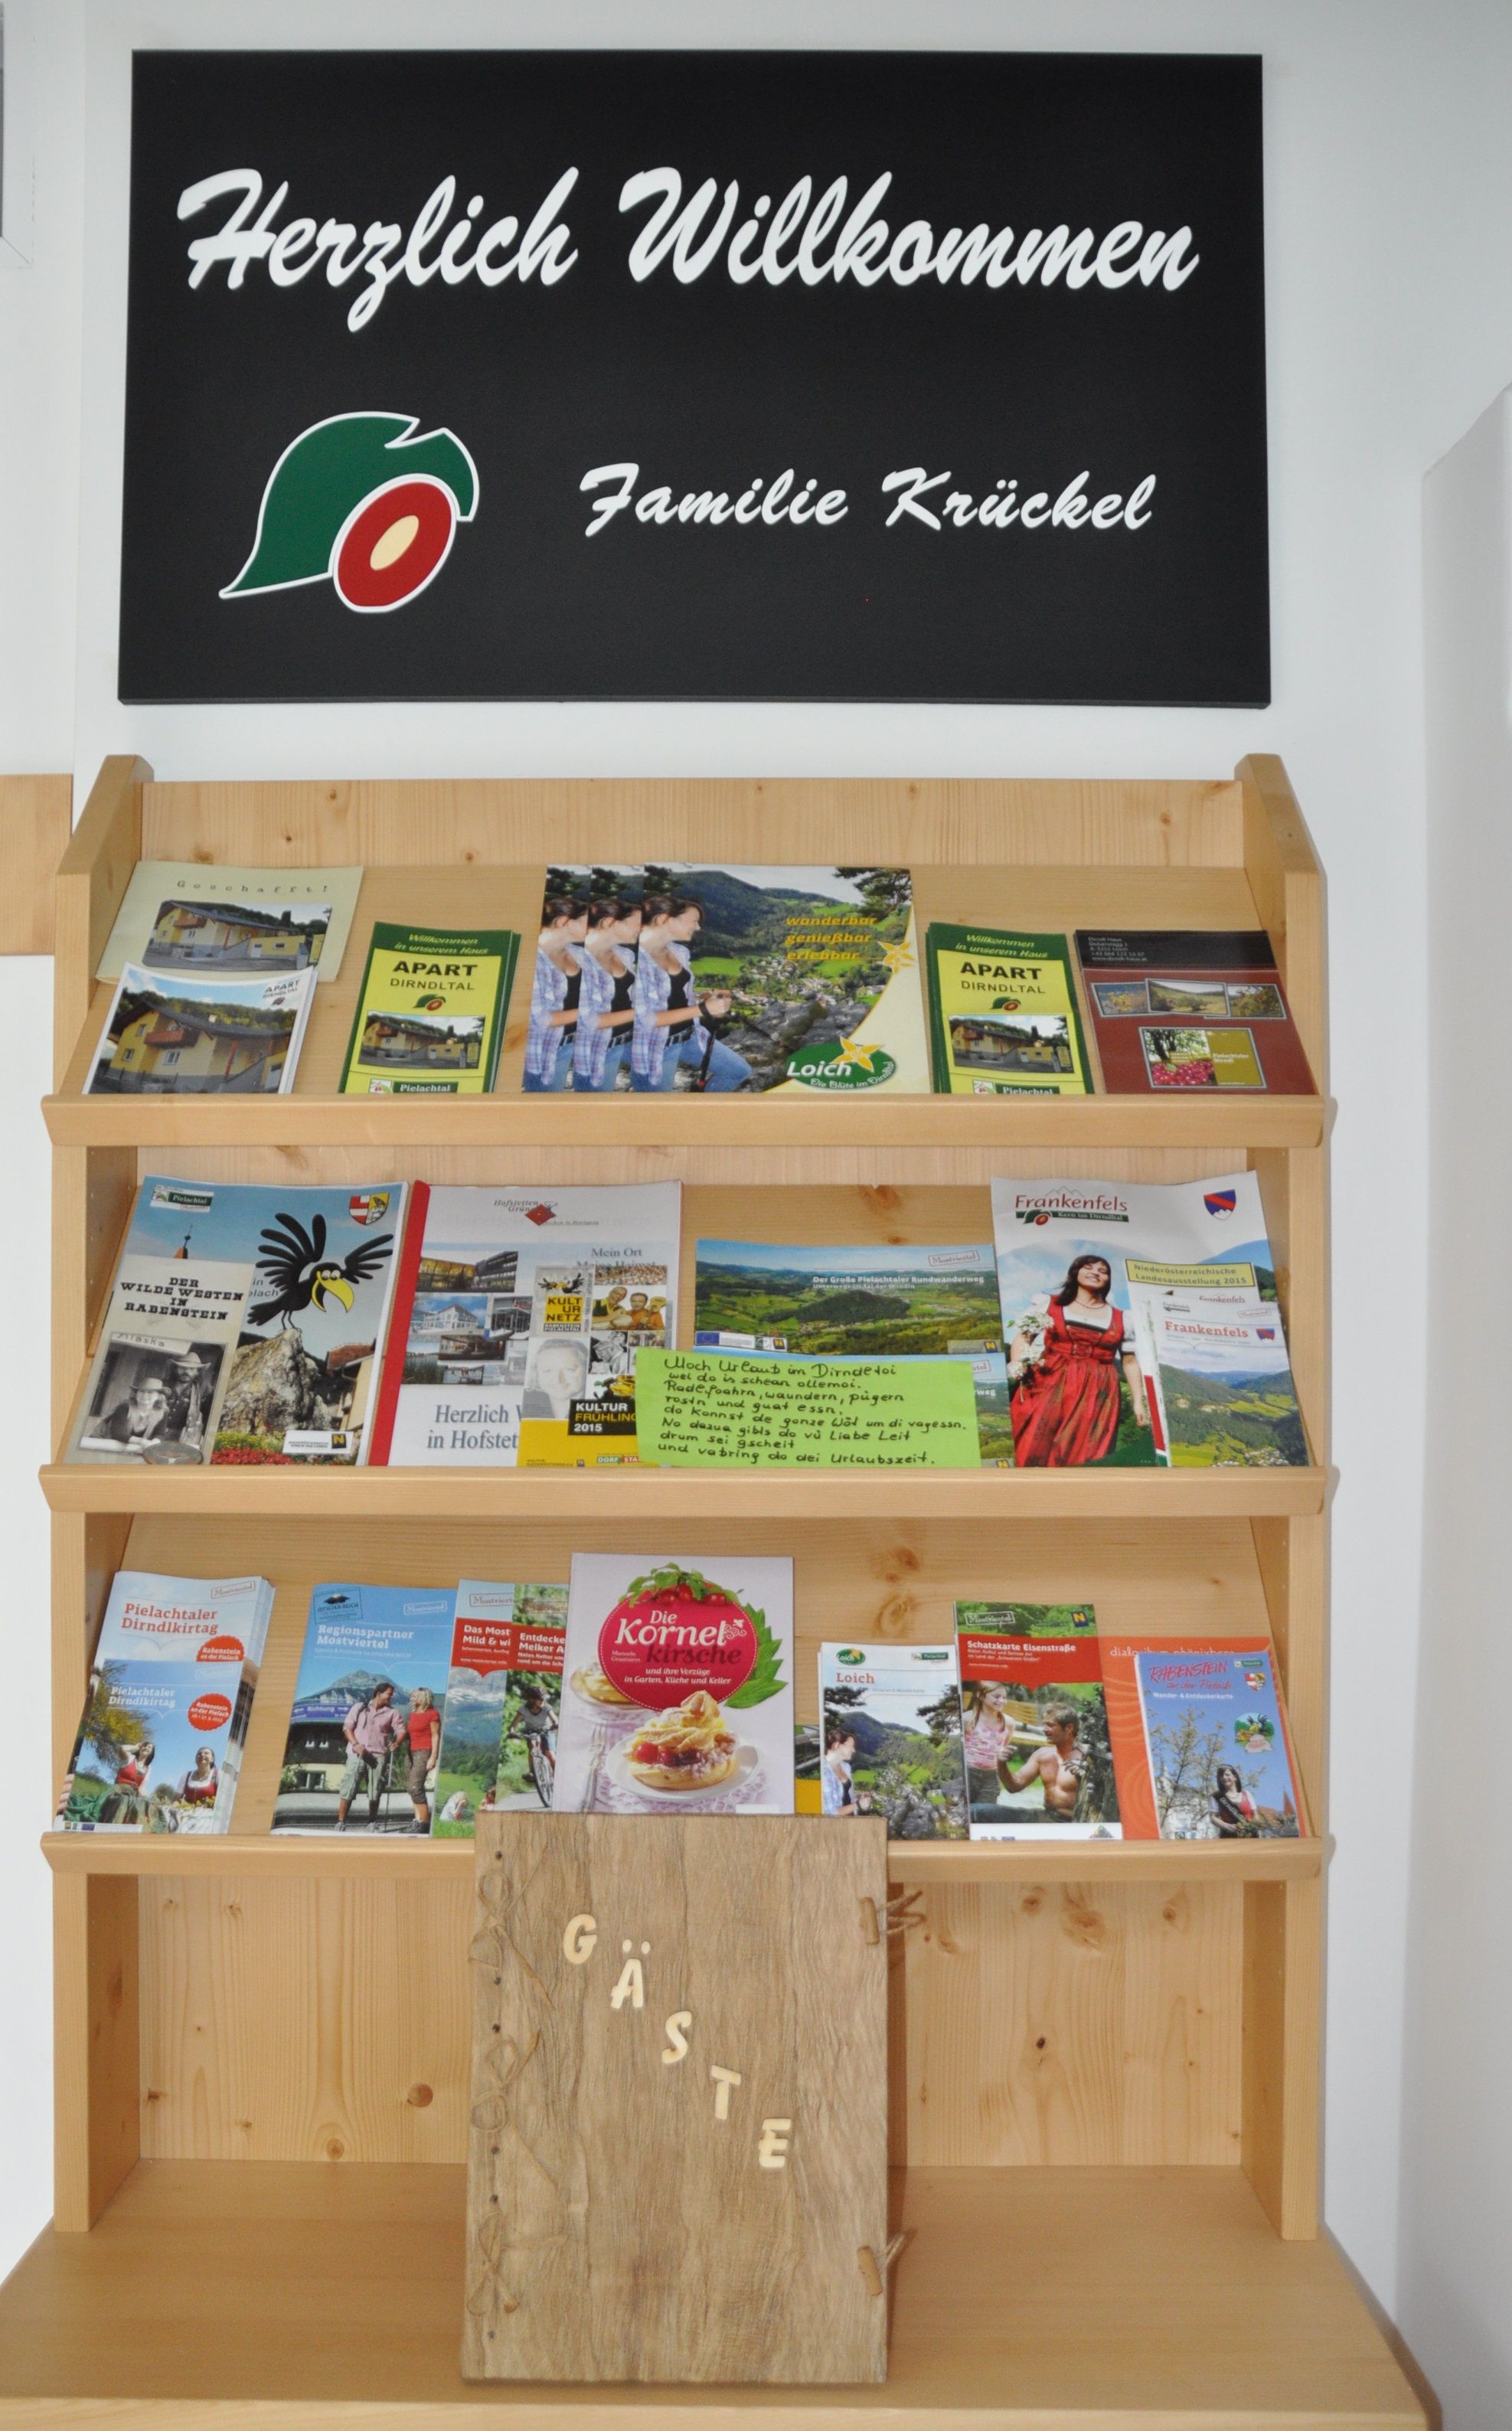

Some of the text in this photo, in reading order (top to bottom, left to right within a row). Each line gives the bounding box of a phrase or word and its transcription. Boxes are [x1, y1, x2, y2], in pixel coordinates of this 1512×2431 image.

[177, 167, 1200, 332] Herzlich Willkommen
[580, 463, 1157, 537] Familie Krückel
[786, 916, 877, 927] wanderbar
[408, 933, 478, 946] Willkommen
[785, 932, 872, 946] genießbar
[966, 933, 1035, 948] Willkommen
[394, 942, 489, 956] in unserem Haus
[787, 950, 859, 961] erlebbar
[955, 942, 1048, 958] in unserem Haus
[392, 960, 478, 977] APART
[960, 962, 1042, 980] APART
[264, 979, 301, 994] APART
[390, 977, 475, 991] DIRNDLTAL
[961, 980, 1047, 994] DIRNDLTAL
[786, 1060, 852, 1077] Loich
[400, 1083, 451, 1093] Pielachtal
[810, 1077, 827, 1087] Die
[829, 1080, 854, 1088] Blüte
[1002, 1086, 1053, 1094] Pielachtal
[173, 1194, 207, 1204] Pielachtal
[1015, 1194, 1128, 1211] Frankenfels
[591, 1247, 643, 1257] Mein Ort
[1134, 1264, 1236, 1275] Niederösterreichische
[169, 1277, 199, 1287] DER
[1136, 1273, 1220, 1285] Landesausstellung
[120, 1282, 244, 1301] WILDE WESTEN
[170, 1298, 188, 1307] IN
[547, 1297, 582, 1305] KULT
[124, 1302, 229, 1320] RABENSTEIN
[546, 1313, 580, 1322] NETZ
[1164, 1321, 1249, 1338] Frankenfels
[665, 1356, 710, 1371] Moch
[788, 1364, 805, 1375] im
[697, 1372, 717, 1382] do
[723, 1374, 735, 1384] is
[740, 1376, 790, 1387] schean
[434, 1404, 509, 1423] Herzlich
[576, 1403, 628, 1412] KULTUR
[717, 1400, 745, 1409] und
[753, 1402, 789, 1413] guat
[664, 1404, 683, 1414] do
[752, 1413, 772, 1423] de
[779, 1416, 825, 1429] gonze
[888, 1418, 903, 1428] di
[573, 1423, 603, 1433] 2015
[661, 1417, 681, 1428] No
[690, 1420, 732, 1433] dazua
[779, 1428, 797, 1439] do
[878, 1430, 910, 1440] Leit
[426, 1430, 444, 1449] in
[660, 1431, 795, 1452] drum sei gscheit
[658, 1443, 688, 1453] und
[698, 1446, 759, 1464] vabring
[768, 1451, 787, 1461] do
[795, 1452, 820, 1462] dei
[124, 1603, 217, 1619] Pielachtaler
[650, 1610, 678, 1624] Die
[1073, 1612, 1086, 1622] N
[121, 1617, 219, 1635] Dirndlkirtag
[318, 1625, 415, 1639] Regionspartner
[464, 1625, 511, 1635] Das Most
[615, 1619, 727, 1646] Kornel
[317, 1635, 389, 1648] Mostviertel
[463, 1635, 485, 1644] Mild
[520, 1632, 565, 1644] Entdecke
[519, 1642, 554, 1652] Melker
[967, 1640, 1076, 1653] Schatzkarte Eisenstraße
[646, 1645, 742, 1664] kirsche
[836, 1672, 875, 1684] Loich
[1150, 1661, 1227, 1683] RABENSTEIN
[111, 1687, 175, 1697] Pielachtaler
[108, 1696, 176, 1708] Dirndlkirtag
[196, 1701, 228, 1711] Rabenstein
